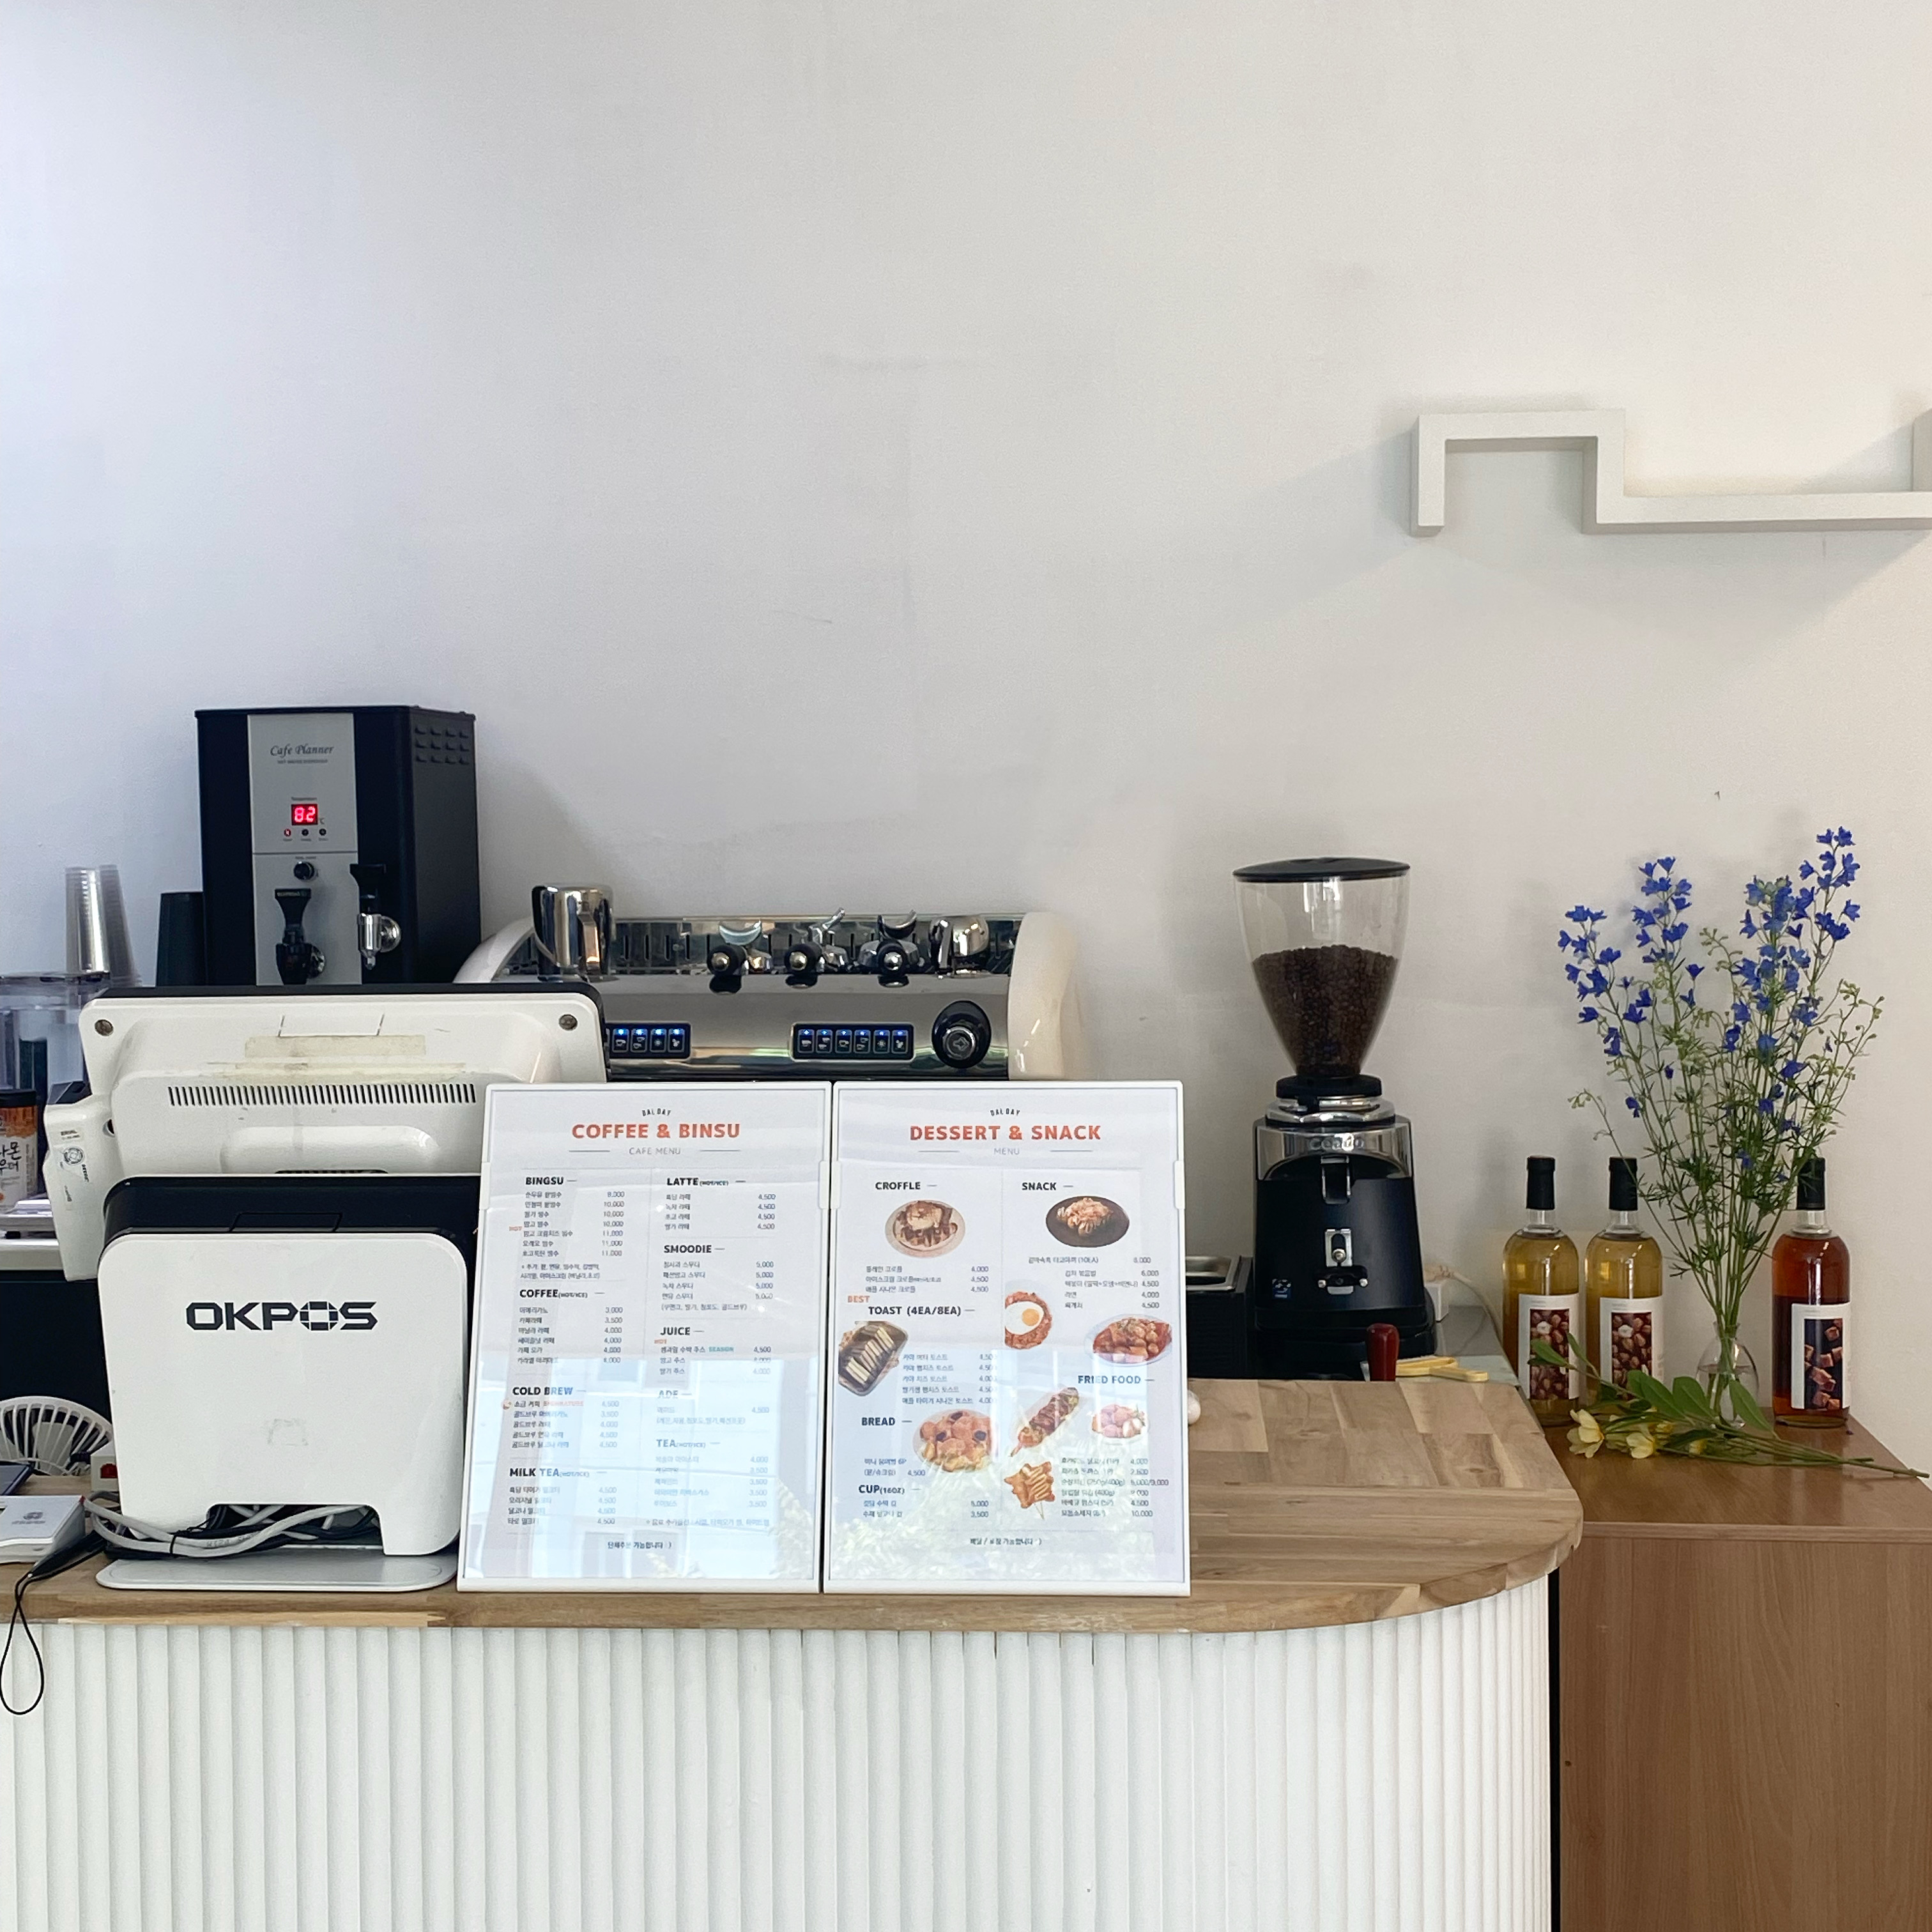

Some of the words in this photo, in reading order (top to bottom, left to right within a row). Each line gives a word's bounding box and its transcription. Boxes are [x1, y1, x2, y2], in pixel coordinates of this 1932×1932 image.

[270, 743, 293, 758] Cafe
[295, 743, 334, 755] Planner
[294, 806, 316, 823] 82
[657, 1108, 671, 1116] DAY
[990, 1108, 1003, 1117] DAL
[1006, 1108, 1020, 1116] DAY
[572, 1124, 648, 1138] COFFEE
[656, 1124, 671, 1138] &
[678, 1123, 740, 1138] BINSU
[910, 1125, 1000, 1140] DESSERT
[1008, 1125, 1023, 1140] &
[1031, 1125, 1101, 1140] SNACK
[525, 1177, 564, 1185] BINGSU
[875, 1181, 921, 1190] CROFFLE
[1022, 1182, 1057, 1191] SNACK
[664, 1245, 712, 1253] SMOODIE
[868, 1306, 902, 1316] TOAST
[907, 1306, 962, 1316] (4EA/8EA)
[186, 1301, 378, 1331] OKPOS
[660, 1327, 691, 1335] JUICE
[1078, 1376, 1108, 1384] FRIED
[1112, 1376, 1141, 1384] FOOD
[512, 1387, 540, 1395] COLD
[544, 1387, 573, 1395] BREW
[861, 1417, 895, 1426] BREAD
[510, 1468, 536, 1477] MILK
